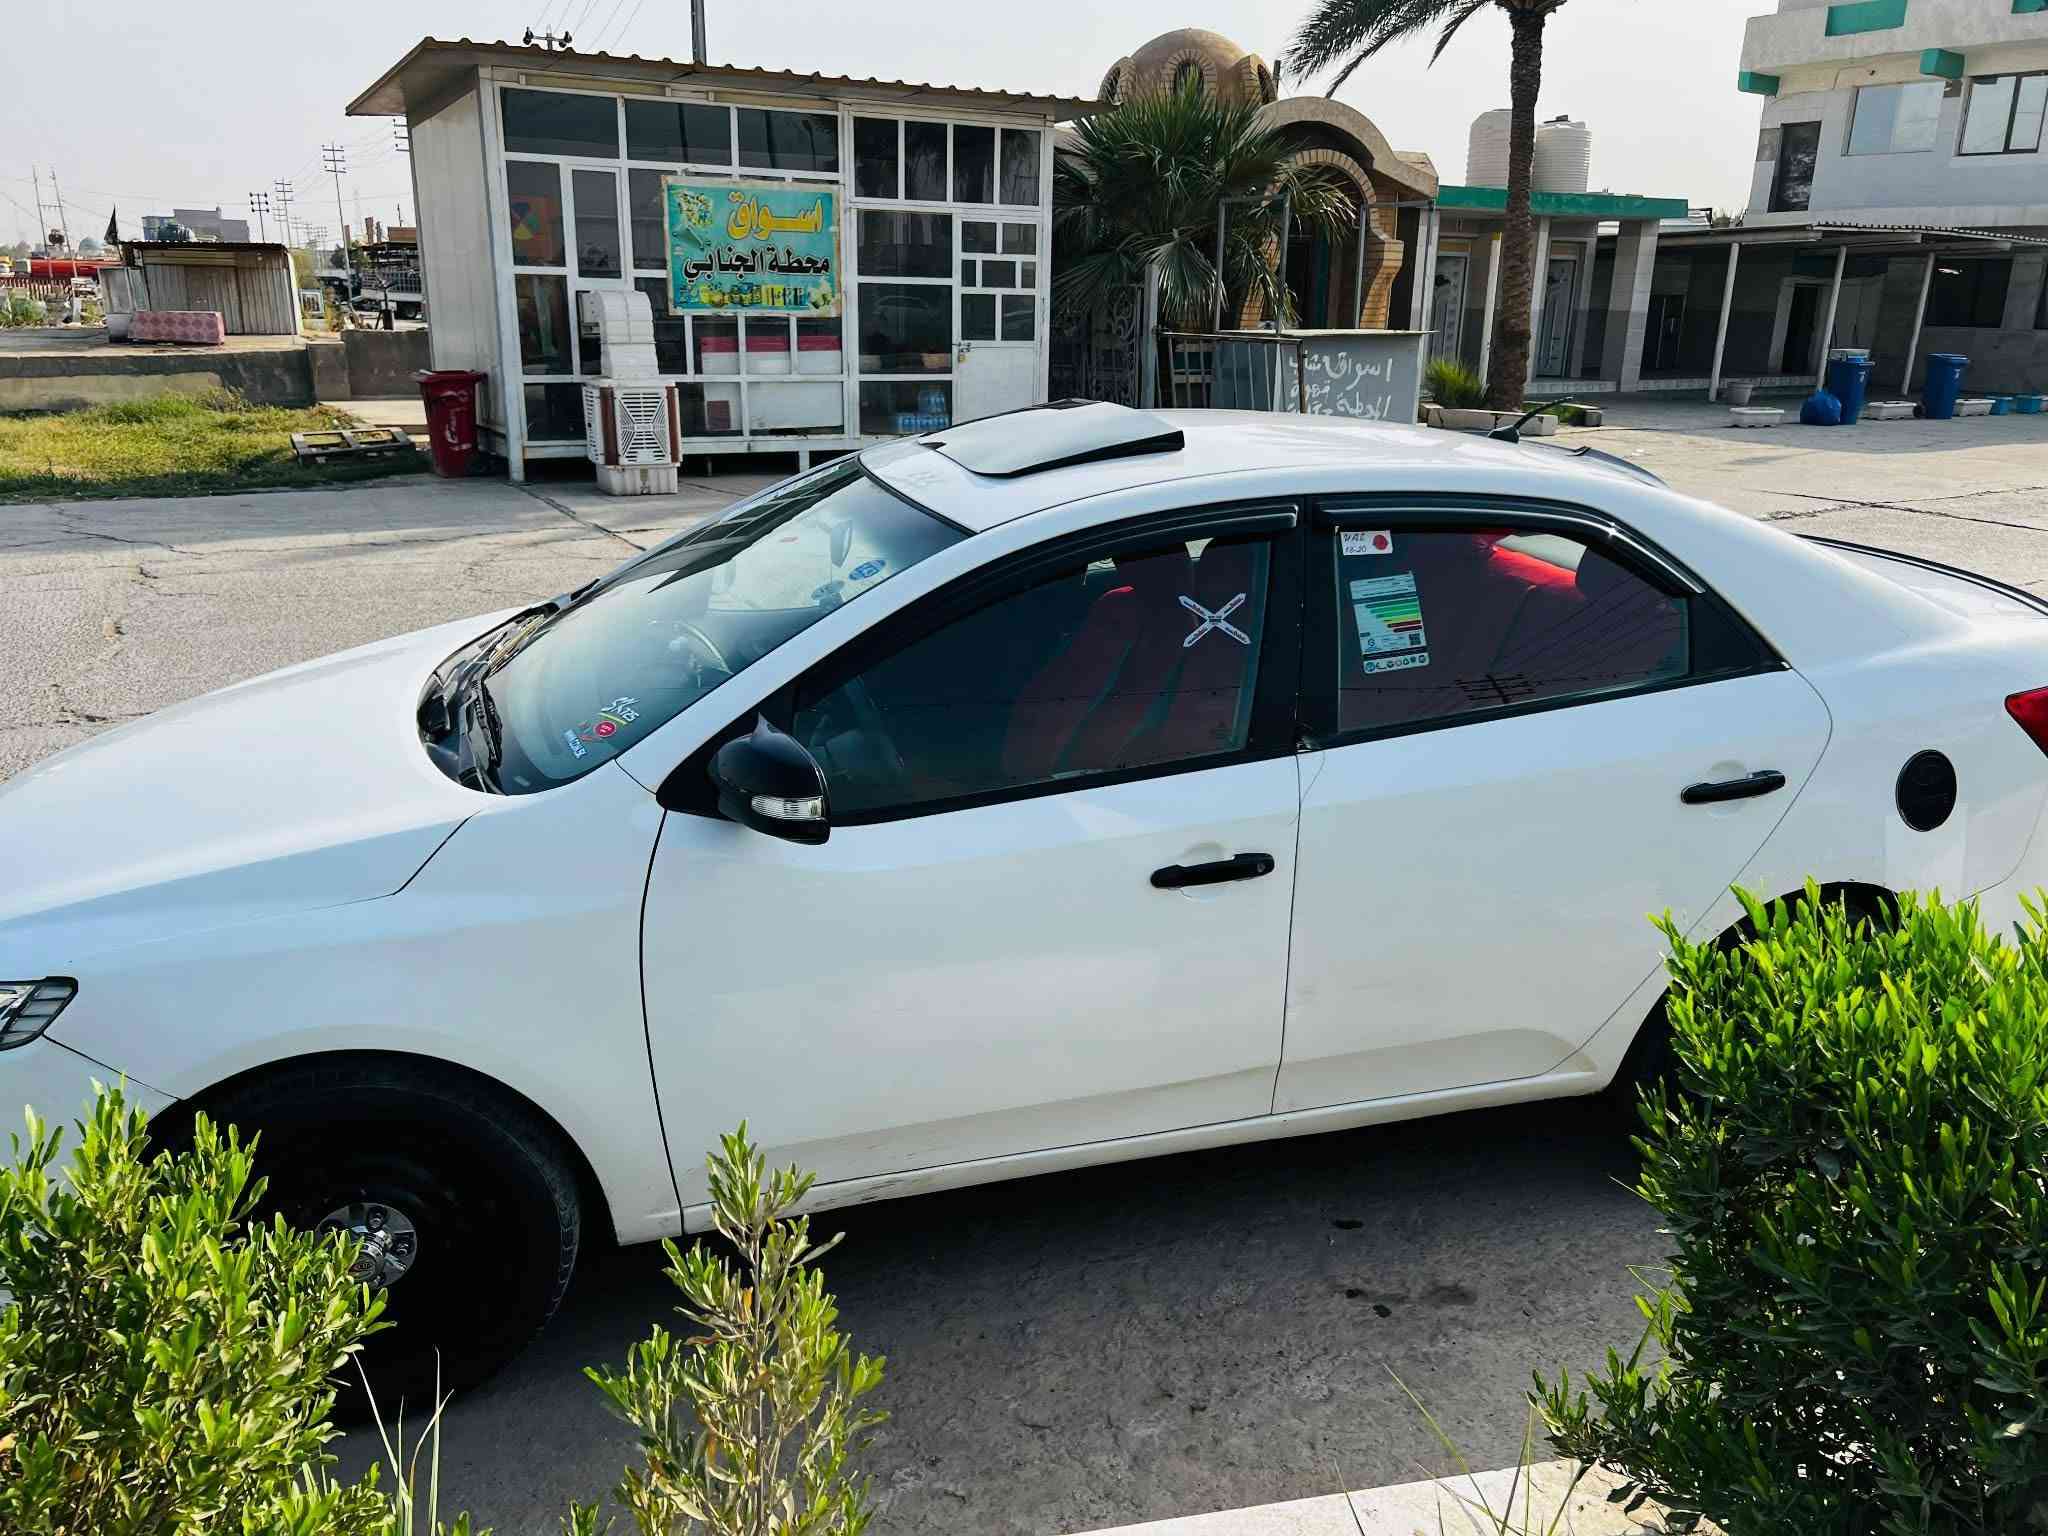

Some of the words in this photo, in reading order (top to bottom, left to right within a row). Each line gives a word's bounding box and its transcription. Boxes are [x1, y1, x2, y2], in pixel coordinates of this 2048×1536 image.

[727, 192, 823, 240] اسواق
[683, 245, 766, 283] الجنابي
[767, 244, 831, 274] محطة
